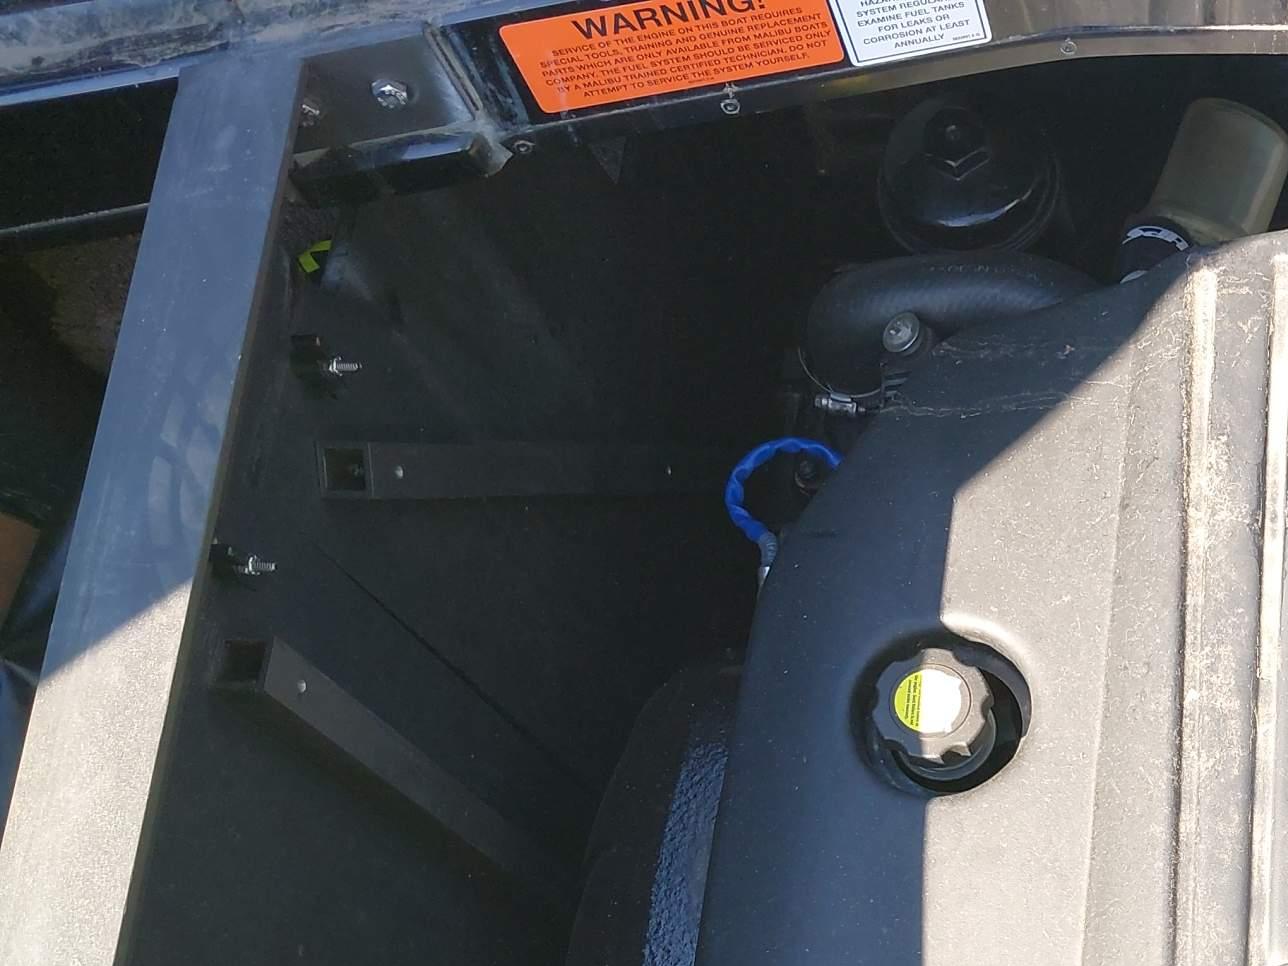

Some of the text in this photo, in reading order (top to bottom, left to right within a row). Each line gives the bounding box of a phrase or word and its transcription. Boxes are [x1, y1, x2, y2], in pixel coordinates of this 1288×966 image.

[551, 43, 596, 55] SERVICE
[614, 36, 634, 44] THE
[637, 29, 676, 40] ENGINE
[695, 21, 719, 30] THIS
[720, 16, 748, 26] BOAT
[750, 7, 803, 20] REQUIRES
[857, 4, 897, 16] SYSTEM
[858, 1, 965, 26] EXAMINE FUEL TANKS
[863, 27, 923, 44] CORROSION
[940, 18, 970, 29] LEAST
[878, 23, 898, 31] FOR
[901, 16, 933, 27] LEAKS
[540, 54, 584, 67] SPECIAL
[624, 39, 673, 52] TRAINING
[674, 35, 697, 43] AND
[699, 26, 745, 39] GENUINE
[747, 13, 822, 31] REPLACEMENT
[542, 21, 828, 76] PARTS WHICH ARE ONLY AVAILABLE FROM MALIBU BOATS
[600, 67, 621, 75] THE
[622, 62, 648, 71] FUEL
[650, 55, 691, 66] SYSTEM
[693, 47, 735, 59] SHOULD
[753, 35, 803, 48] SERVICED
[805, 30, 832, 39] ONLY
[894, 33, 945, 47] ANNUALLY
[582, 76, 622, 87] MALIBU
[623, 68, 668, 80] TRAINED
[669, 58, 721, 72] CERTIFIED
[806, 40, 828, 48] NOT
[582, 84, 628, 96] ATTEMPT
[646, 73, 690, 85] SERVICE
[691, 69, 712, 77] THE
[713, 62, 754, 74] SYSTEM
[756, 52, 810, 66] YOURSELF.
